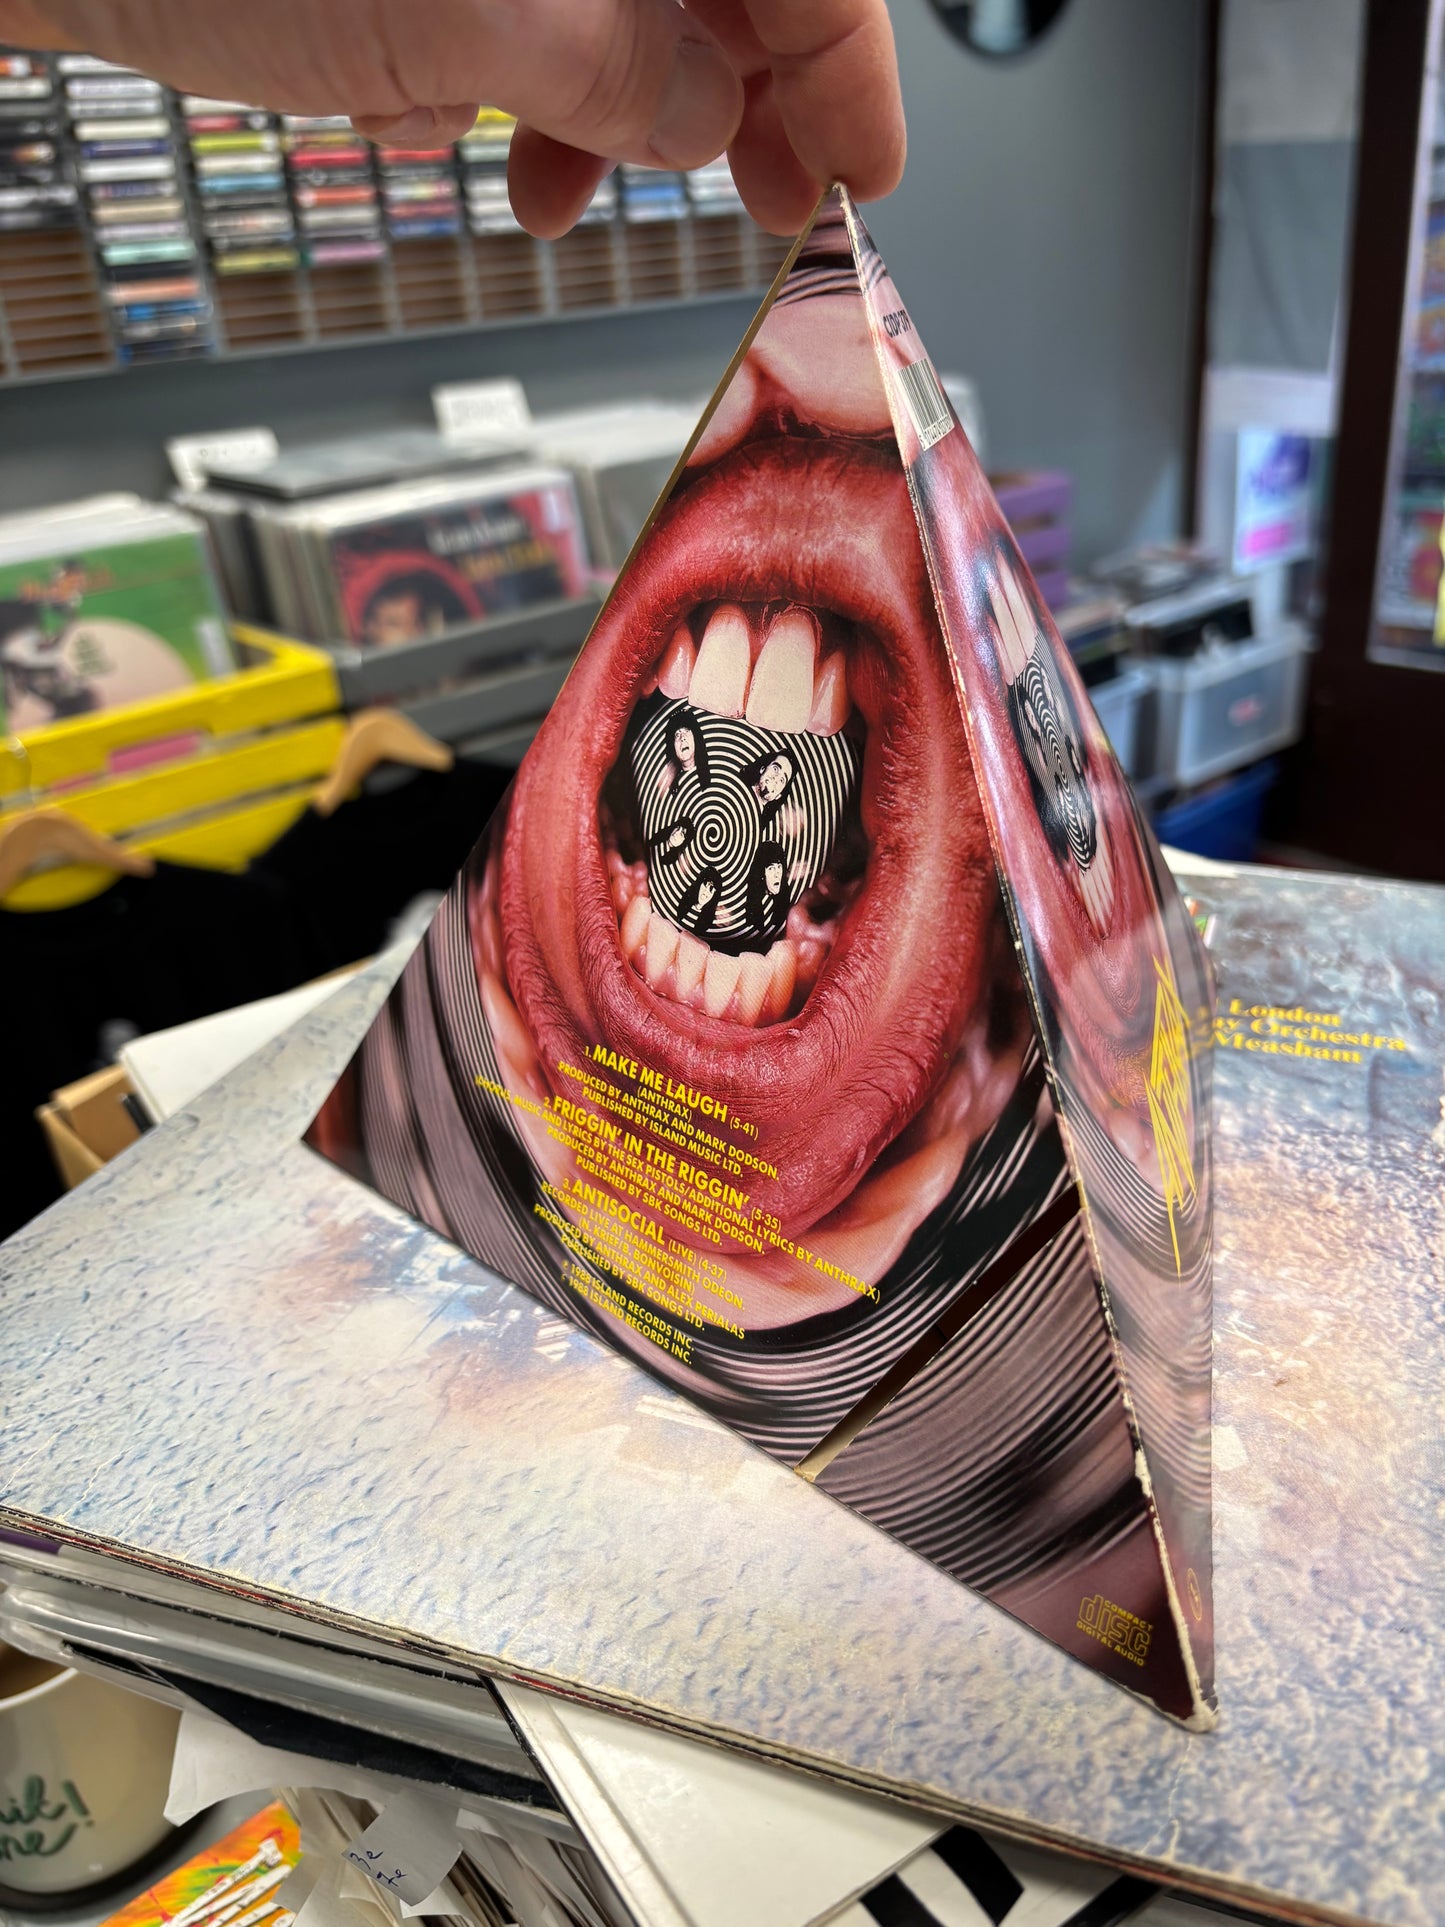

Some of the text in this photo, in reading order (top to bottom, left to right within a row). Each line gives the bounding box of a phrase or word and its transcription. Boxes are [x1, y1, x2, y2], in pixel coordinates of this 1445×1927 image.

[1214, 1031, 1362, 1064] Measham
[1229, 998, 1341, 1027] London
[1250, 1018, 1406, 1050] Orchestra
[557, 1061, 779, 1180] PRODUCED BY ANTHRAX AND MARK DODSON.
[593, 1044, 639, 1080] MAKE
[640, 1066, 664, 1092] ME
[665, 1078, 728, 1123] LAUGH
[637, 1085, 692, 1123] (ANTHRAX)
[553, 1095, 622, 1142] FRIGGIN'
[623, 1132, 643, 1156] IN
[646, 1143, 676, 1174] THE
[678, 1160, 750, 1210] RIGGIN'
[582, 1086, 743, 1178] PUBLISHED BY ISLAND MUSIC LTD.
[513, 1095, 541, 1117] MUSIC
[541, 1110, 562, 1128] AND
[562, 1120, 593, 1143] LYRICS
[593, 1136, 607, 1150] BY
[607, 1144, 625, 1160] THE
[626, 1155, 644, 1171] SEX
[756, 1225, 795, 1256] LYRICS
[796, 1246, 814, 1264] BY
[814, 1257, 881, 1305] ANTHRAX)
[546, 1125, 765, 1254] PRODUCED BY ANTHRAX AND MARK DODSON.
[572, 1178, 665, 1246] ANTISOCIAL
[668, 1239, 697, 1266] (LIVE)
[576, 1155, 722, 1246] PUBLISHED BY SBK SONGS LTD.
[534, 1203, 745, 1340] PRODUCED BY ANTHRAX AND ALEX PERIALAS
[541, 1180, 745, 1311] RECORDED LIVE AT HAMMERSMITH ODEON.
[561, 1234, 705, 1331] PUBLISHED BY SBK SONGS LTD.
[633, 1249, 695, 1296] BONVOISIN)
[569, 1276, 588, 1297] 1988
[590, 1290, 625, 1319] ISLAND
[625, 1313, 670, 1349] RECORDS
[671, 1342, 692, 1365] INC.
[571, 1263, 590, 1285] 1988
[591, 1278, 627, 1306] ISLAND
[627, 1300, 673, 1336] RECORDS
[673, 1329, 695, 1351] INC.
[1076, 1620, 1145, 1667] DIGITAL AUDIO
[1079, 1594, 1151, 1657] disc
[1104, 1600, 1153, 1632] COMPACT
